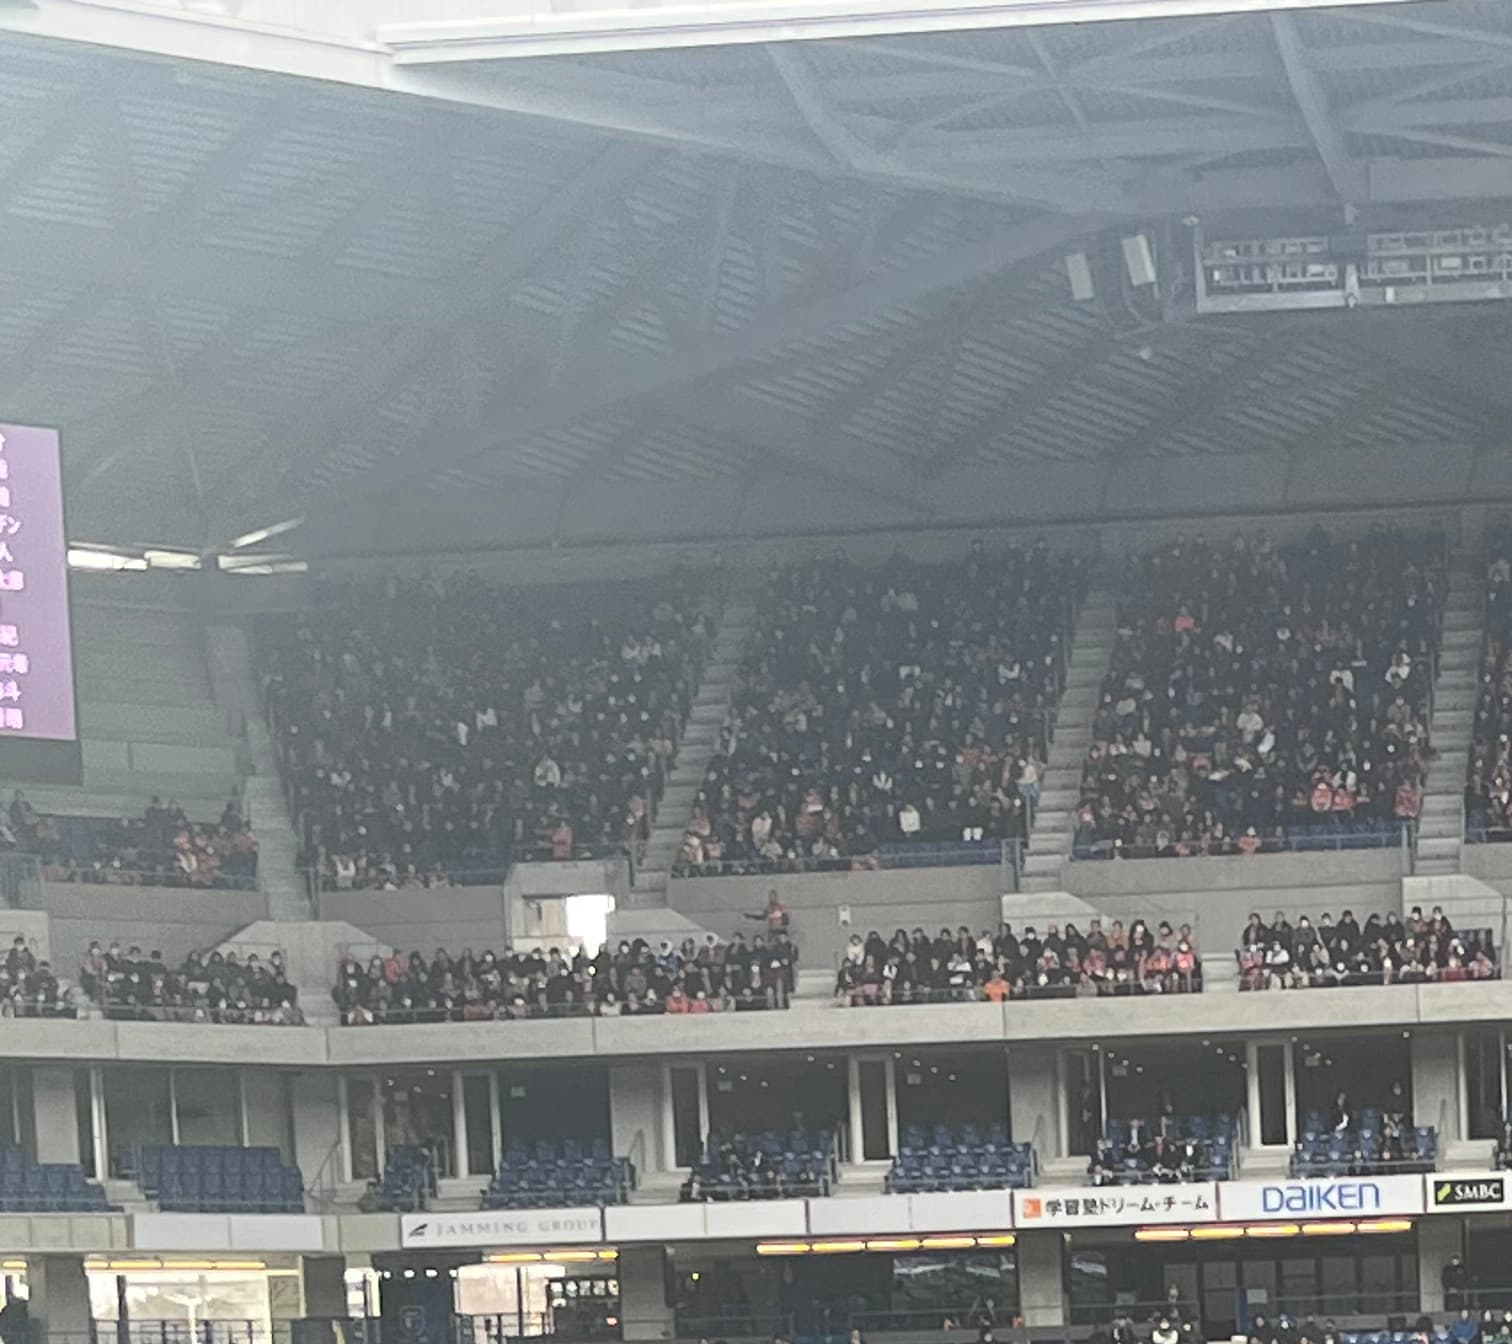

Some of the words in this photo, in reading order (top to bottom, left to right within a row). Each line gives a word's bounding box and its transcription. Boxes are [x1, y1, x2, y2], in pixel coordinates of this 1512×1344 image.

[1454, 1183, 1500, 1200] SMBC
[436, 1221, 528, 1237] JAMMING
[538, 1218, 599, 1233] GROUP
